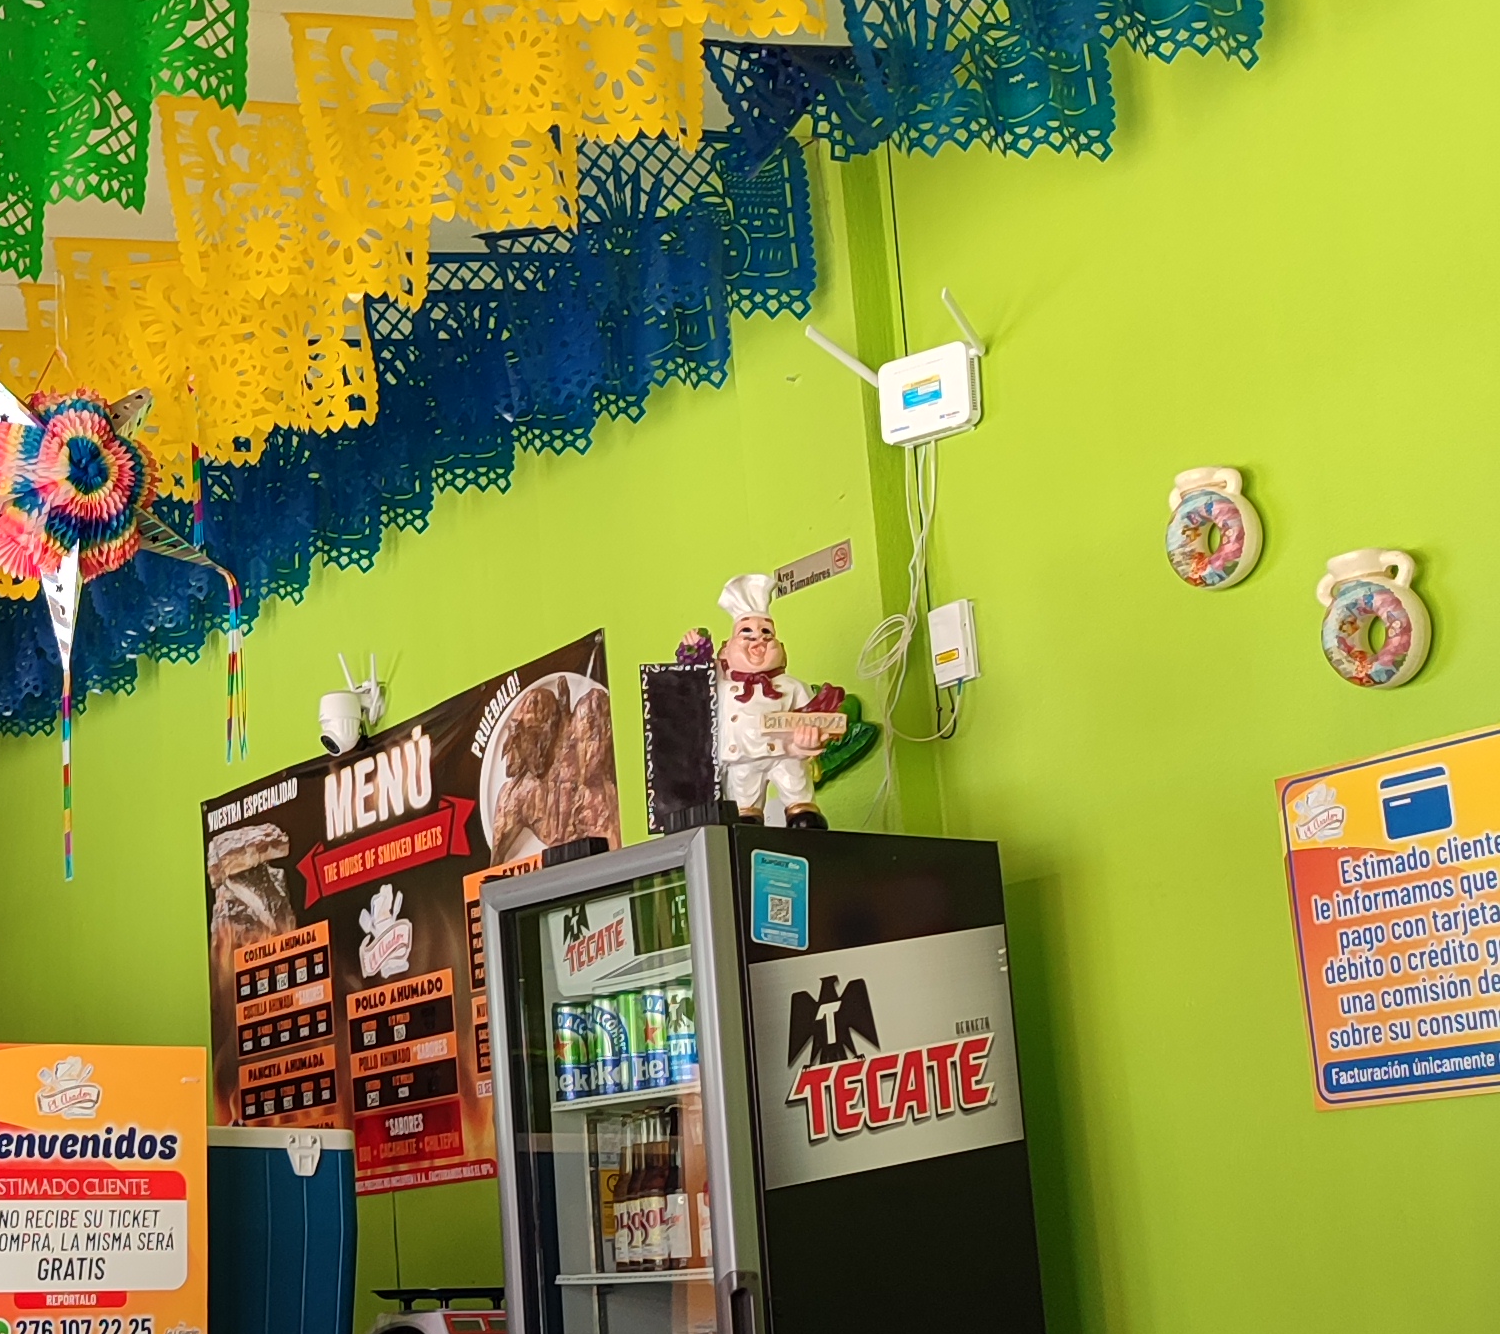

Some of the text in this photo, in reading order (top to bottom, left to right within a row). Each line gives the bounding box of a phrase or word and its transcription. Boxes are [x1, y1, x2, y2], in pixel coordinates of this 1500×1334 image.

[777, 568, 831, 597] No Fumadores
[243, 777, 298, 818] ESPECIALIDAD
[324, 724, 433, 841] MENÚ
[323, 825, 443, 884] THE HOUSE OF SMOKED MEATS
[1340, 845, 1430, 885] Estimado
[1314, 869, 1499, 922] le informamos que
[563, 917, 626, 977] TECATE
[1339, 924, 1386, 954] pago
[1391, 917, 1428, 941] con
[1324, 952, 1385, 985] débito
[1389, 958, 1401, 974] o
[1407, 941, 1480, 972] crédito
[355, 976, 443, 1013] POLLO AHUMADO
[1339, 992, 1376, 1015] una
[1381, 973, 1472, 1009] comisión
[1329, 1019, 1383, 1050] sobre
[1388, 1020, 1411, 1042] su
[785, 1031, 996, 1144] TECATE
[1331, 1050, 1496, 1087] Facturación únicamente
[82, 1178, 151, 1197] CLIENTE
[24, 1209, 79, 1229] RECIBE
[83, 1208, 105, 1229] SU
[108, 1208, 161, 1229] TICKET
[61, 1232, 81, 1253] LA
[85, 1231, 133, 1252] MISMA
[137, 1226, 175, 1252] SERÁ
[36, 1256, 106, 1282] GRATIS
